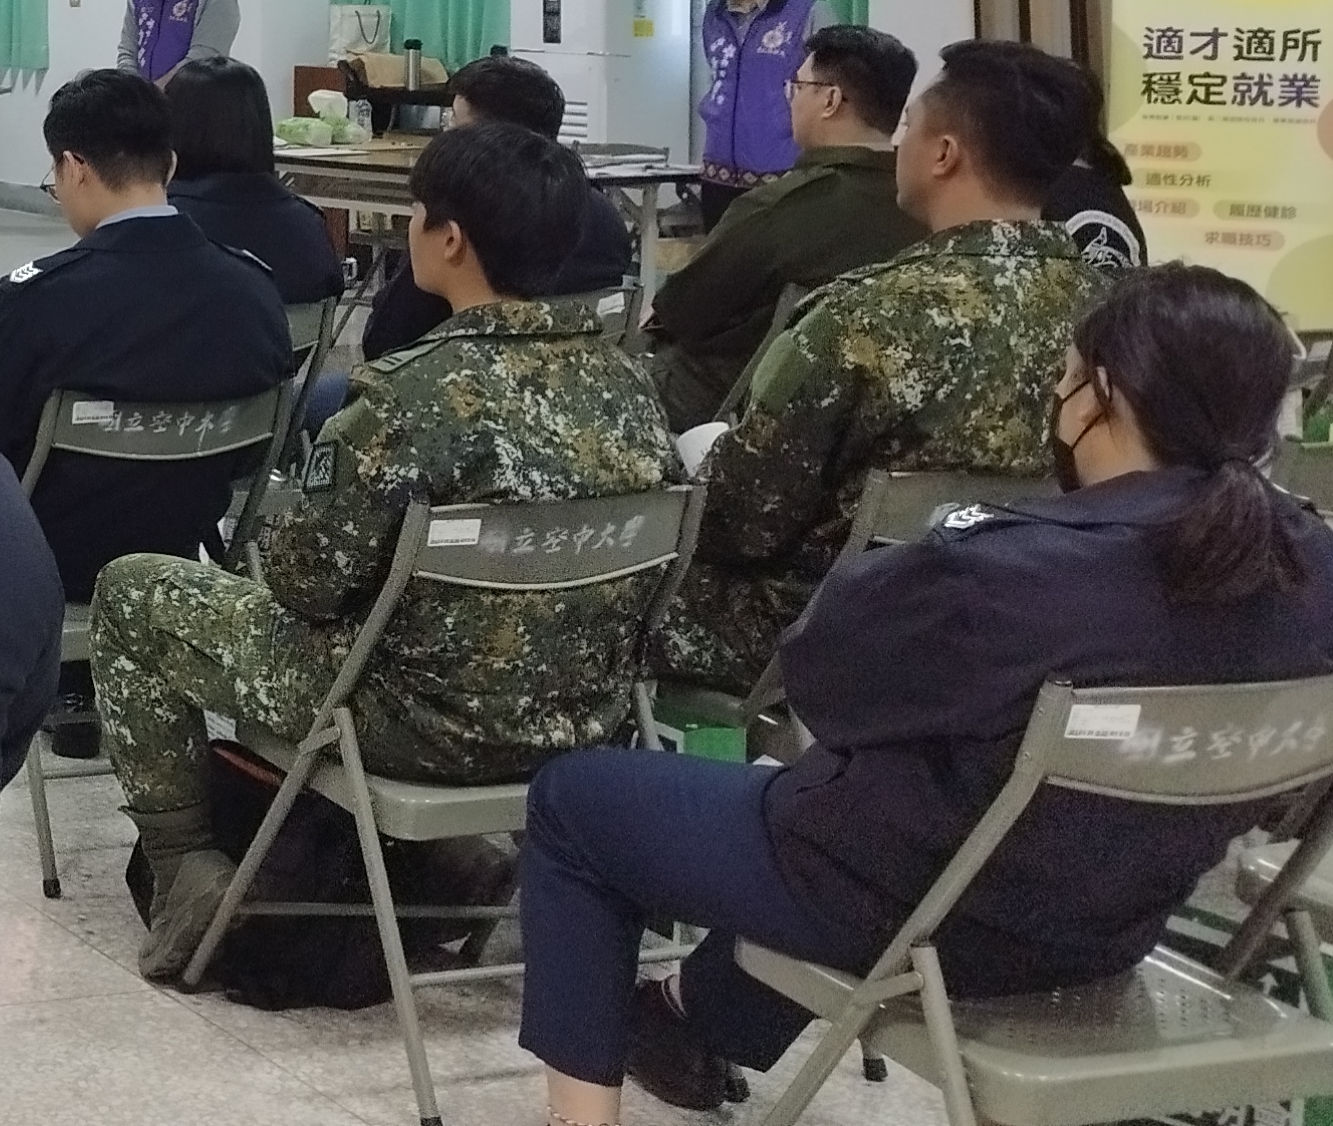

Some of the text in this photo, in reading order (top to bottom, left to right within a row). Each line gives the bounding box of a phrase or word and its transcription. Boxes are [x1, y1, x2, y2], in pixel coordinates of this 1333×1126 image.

[1142, 26, 1322, 62] 適才適所
[1141, 72, 1320, 108] 穩定就業
[1146, 173, 1212, 188] 適性分析
